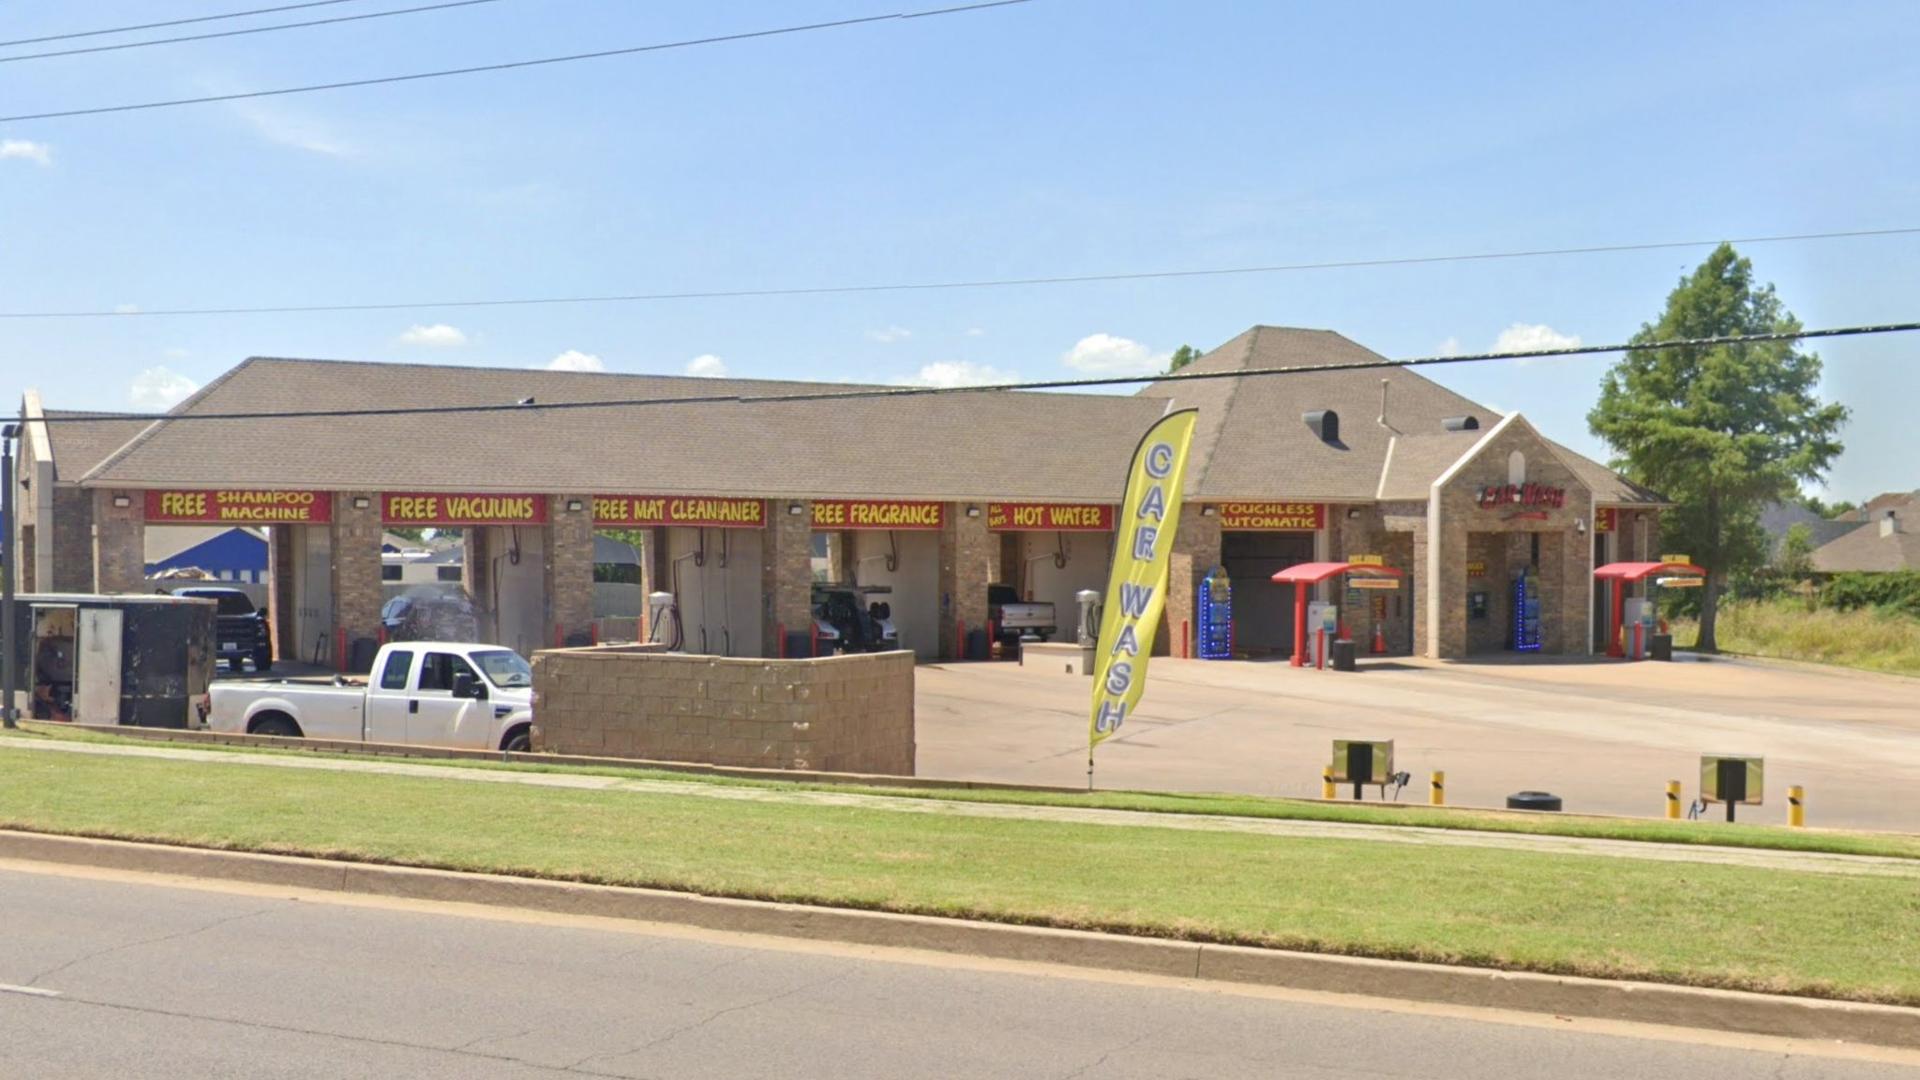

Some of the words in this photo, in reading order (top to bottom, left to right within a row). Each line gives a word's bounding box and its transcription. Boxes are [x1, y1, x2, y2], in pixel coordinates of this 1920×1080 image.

[162, 493, 207, 516] FREE
[217, 491, 314, 504] SHAMPOO
[1133, 443, 1173, 560] CAR
[221, 507, 310, 519] MACHINE
[390, 497, 437, 519] FREE
[446, 497, 534, 519] VACUUMS
[592, 499, 628, 519] FREE
[634, 500, 666, 519] MAT
[850, 504, 939, 524] FRAGRANCE
[1014, 506, 1044, 525] HOT
[1051, 506, 1102, 526] WATER
[1220, 503, 1315, 514] TOUCHLESS
[1220, 516, 1317, 528] AUTOMATIC
[1096, 582, 1154, 734] WASH
